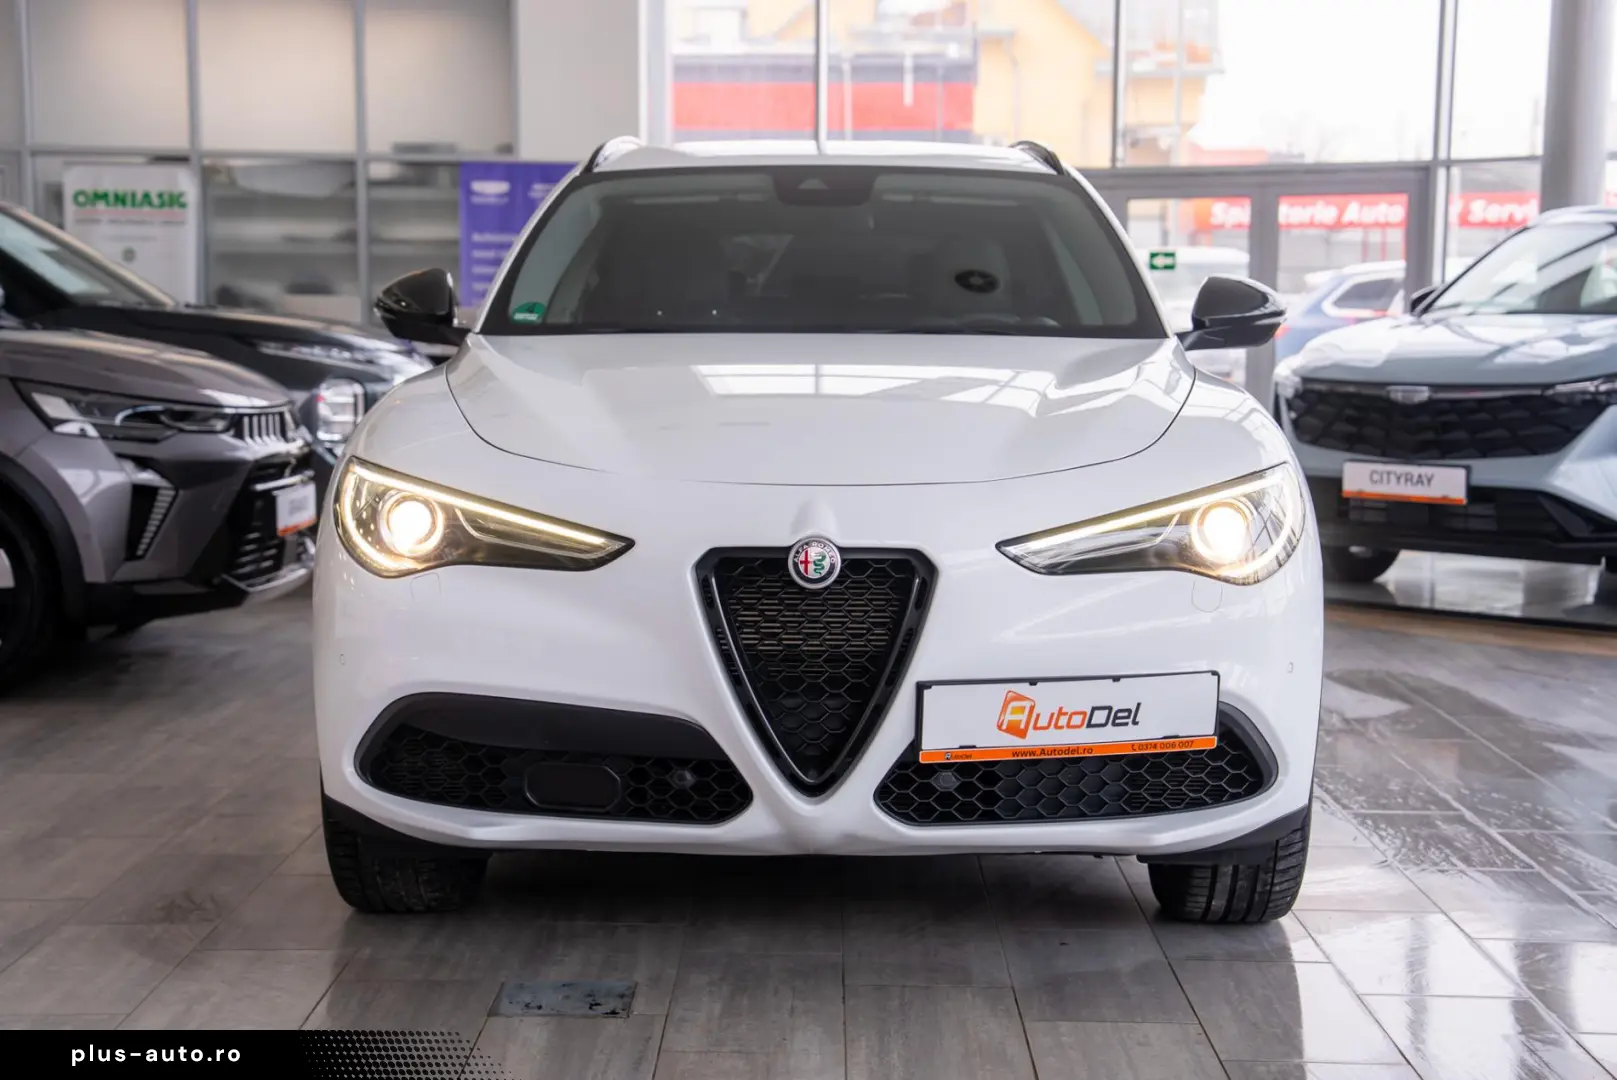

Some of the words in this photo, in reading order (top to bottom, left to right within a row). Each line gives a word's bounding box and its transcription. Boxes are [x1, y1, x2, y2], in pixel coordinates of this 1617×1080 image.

[1342, 201, 1405, 224] Auto
[1369, 469, 1435, 488] CITYRAY
[793, 544, 809, 563] ALFA
[812, 541, 836, 563] ROMEO
[1000, 698, 1142, 734] AutoDel
[1011, 746, 1094, 759] www.Autodel.ro
[1138, 742, 1157, 752] 0374
[1159, 741, 1177, 751] 006
[1178, 740, 1194, 750] 007
